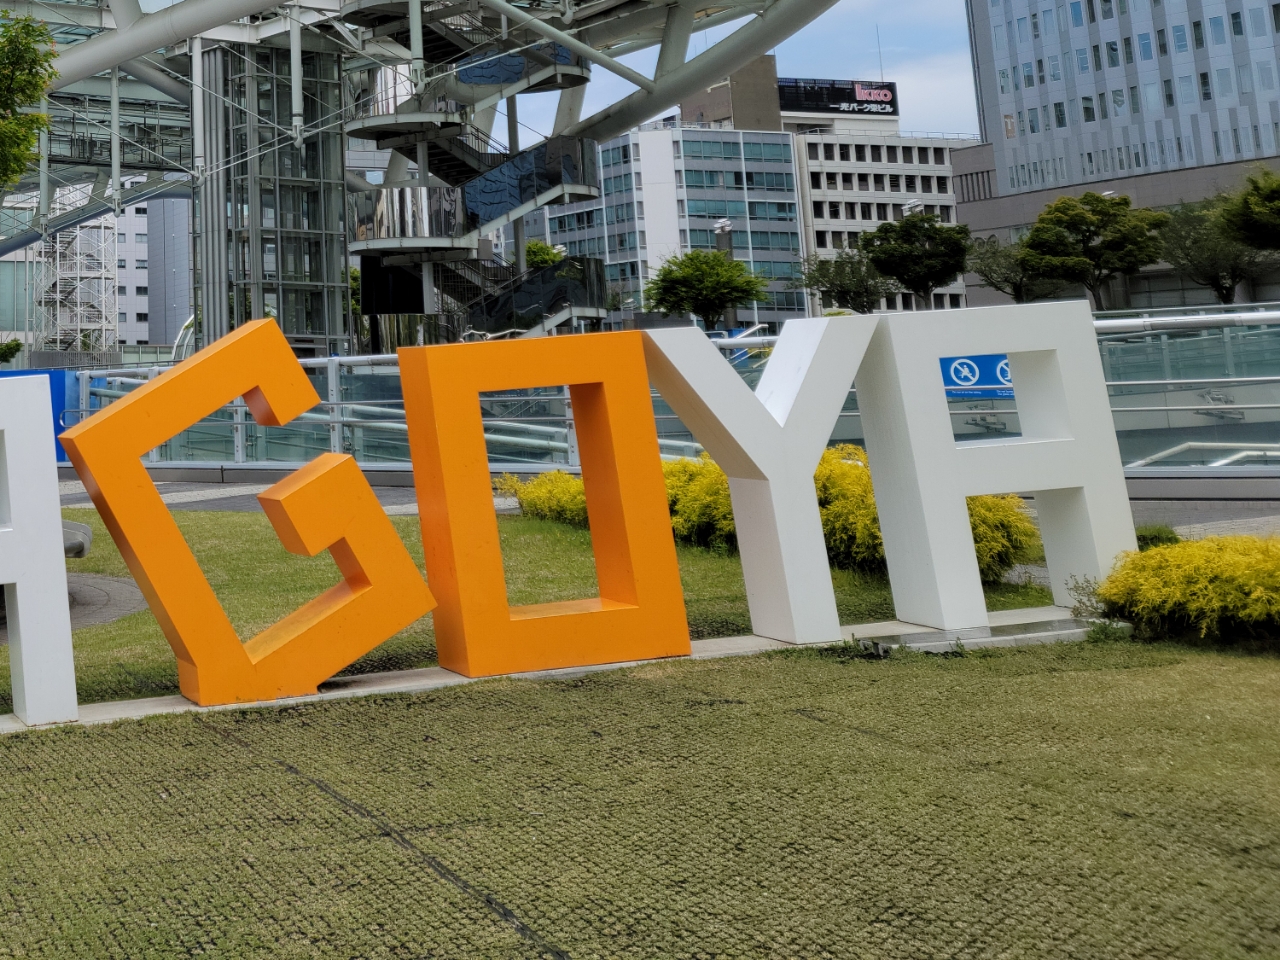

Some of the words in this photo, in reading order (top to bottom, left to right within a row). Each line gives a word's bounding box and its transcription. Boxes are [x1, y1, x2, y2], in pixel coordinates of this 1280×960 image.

[829, 102, 894, 113] 一光パーク栄ビル
